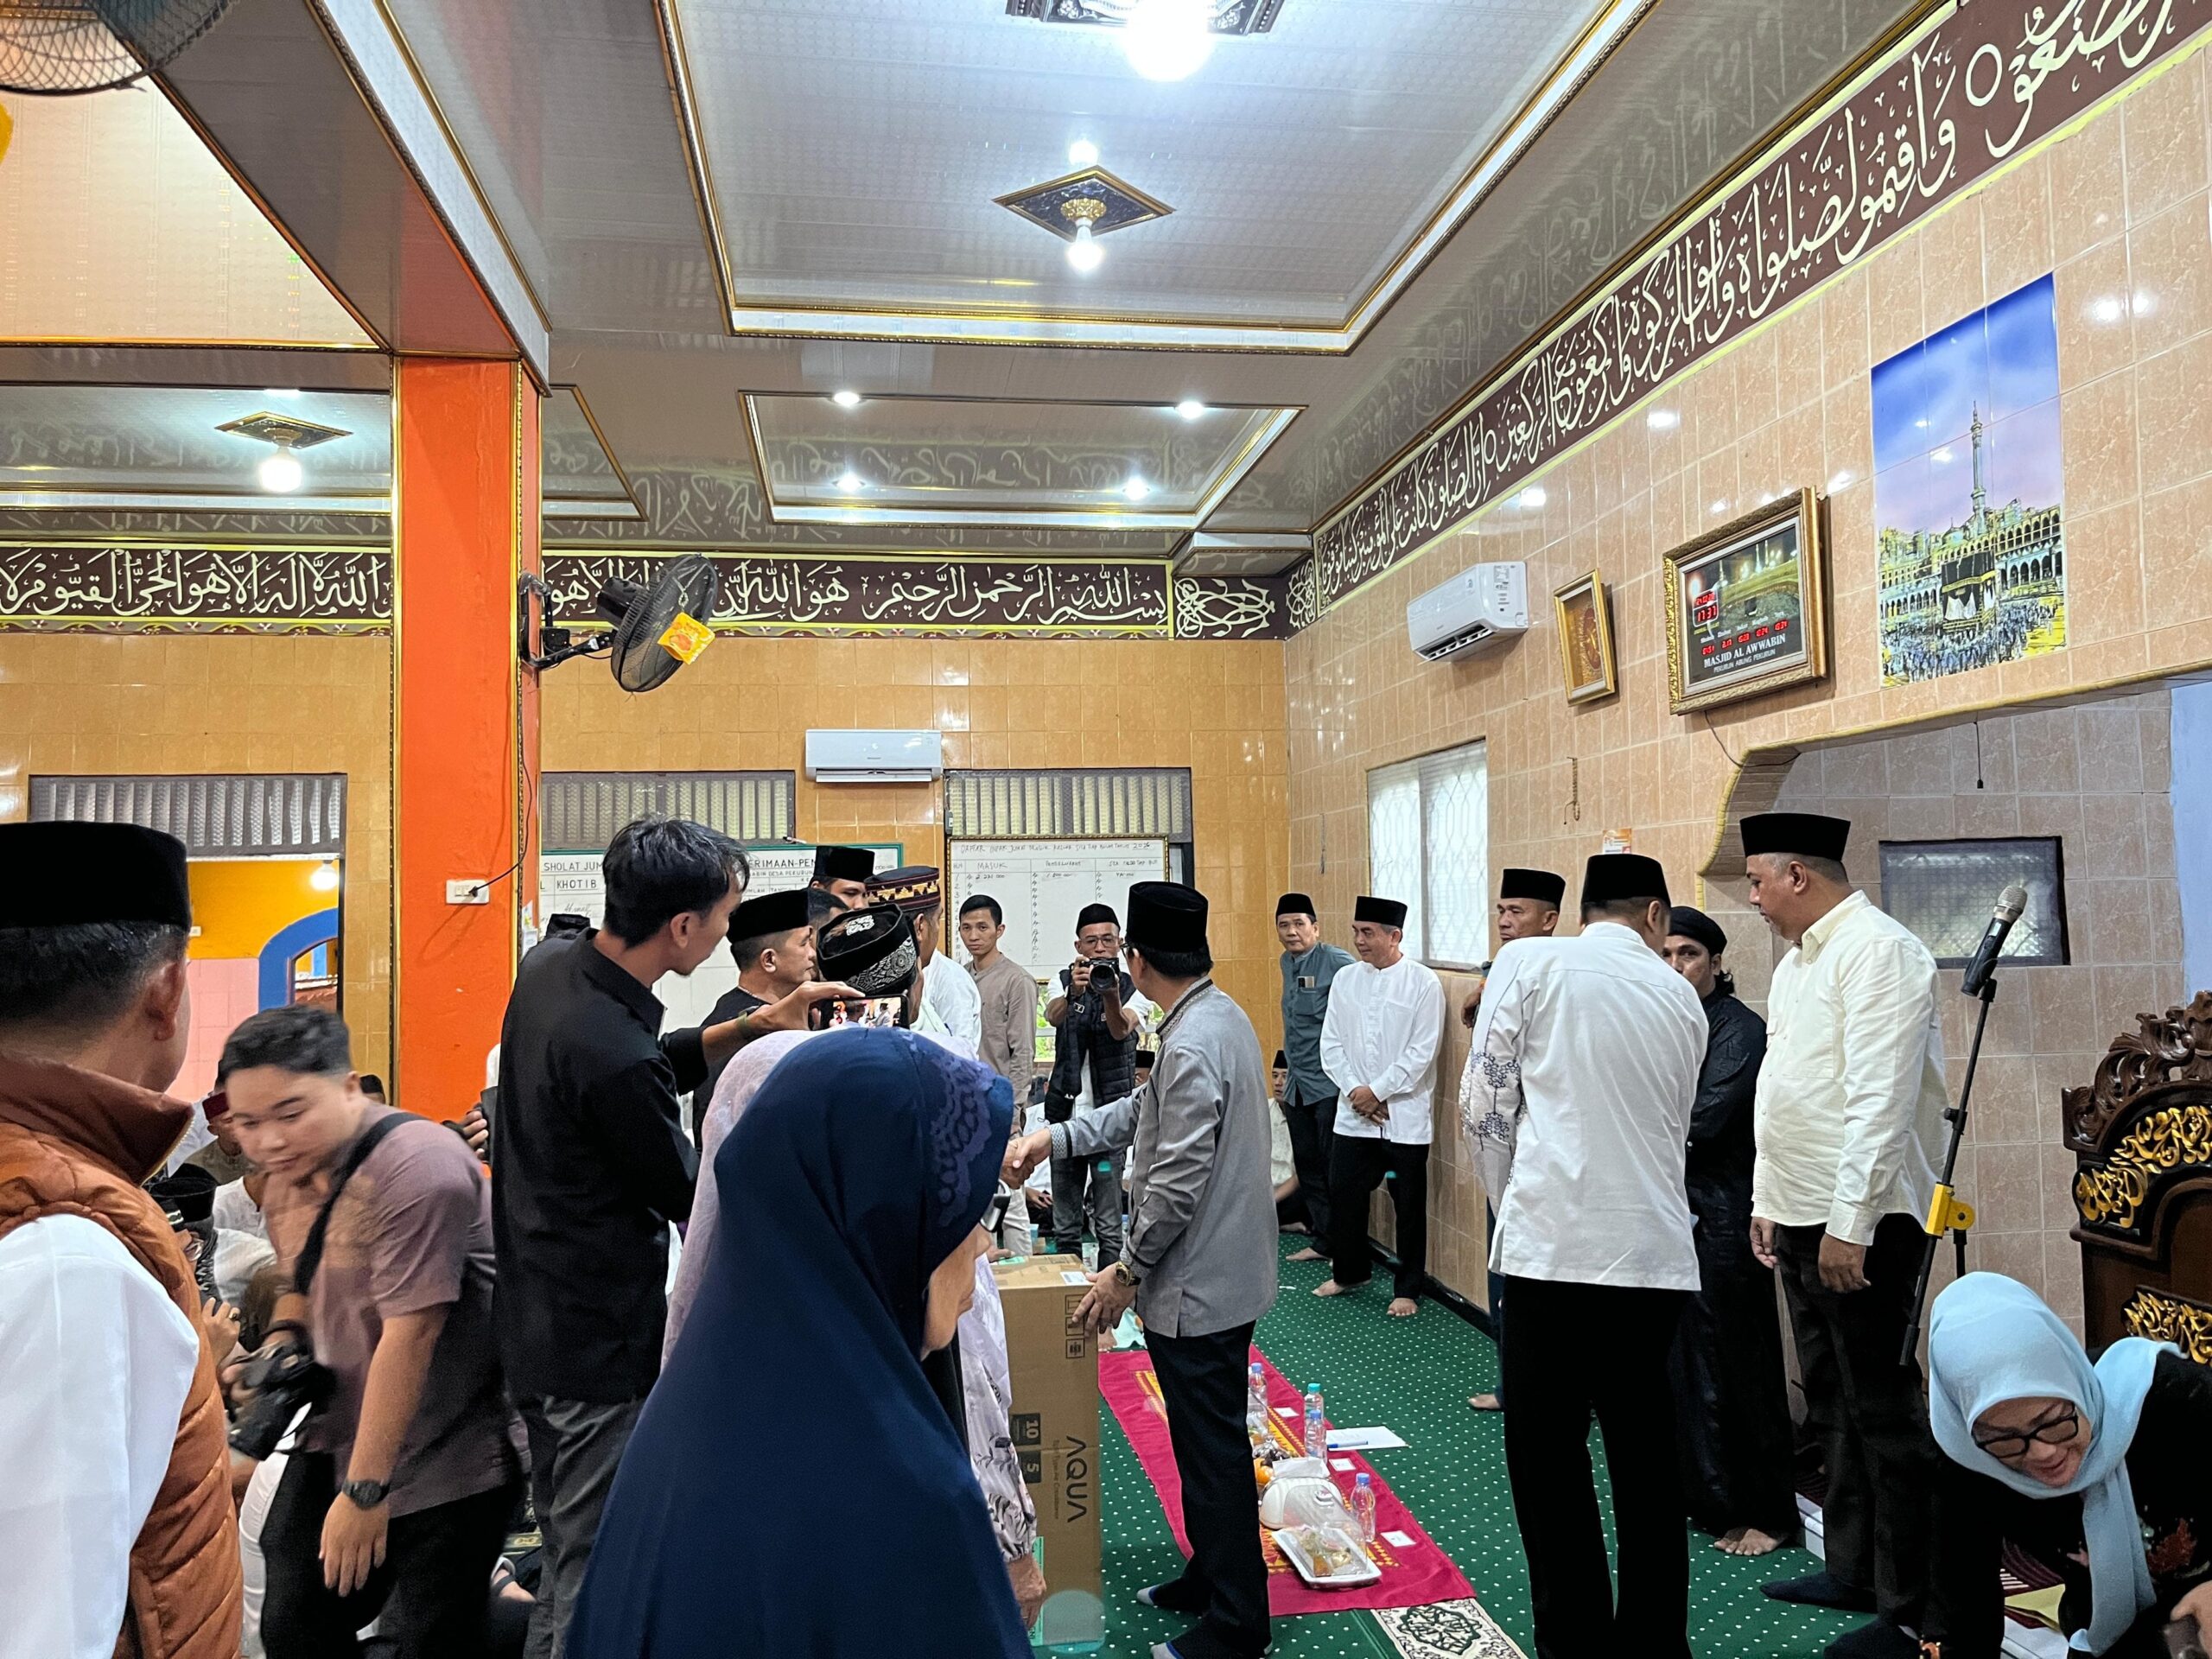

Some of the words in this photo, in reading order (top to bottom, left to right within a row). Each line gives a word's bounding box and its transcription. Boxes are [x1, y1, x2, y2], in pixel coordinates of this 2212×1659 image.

[1703, 652, 1732, 669] MASJID
[1733, 647, 1745, 659] AL
[1745, 633, 1786, 655] AWWABIN
[543, 861, 581, 872] SHOLAT
[977, 861, 1008, 871] MASUK
[556, 879, 597, 889] KHOTIB
[1026, 1420, 1039, 1438] 10
[1027, 1463, 1039, 1475] 5
[1065, 1435, 1088, 1523] AQUA
